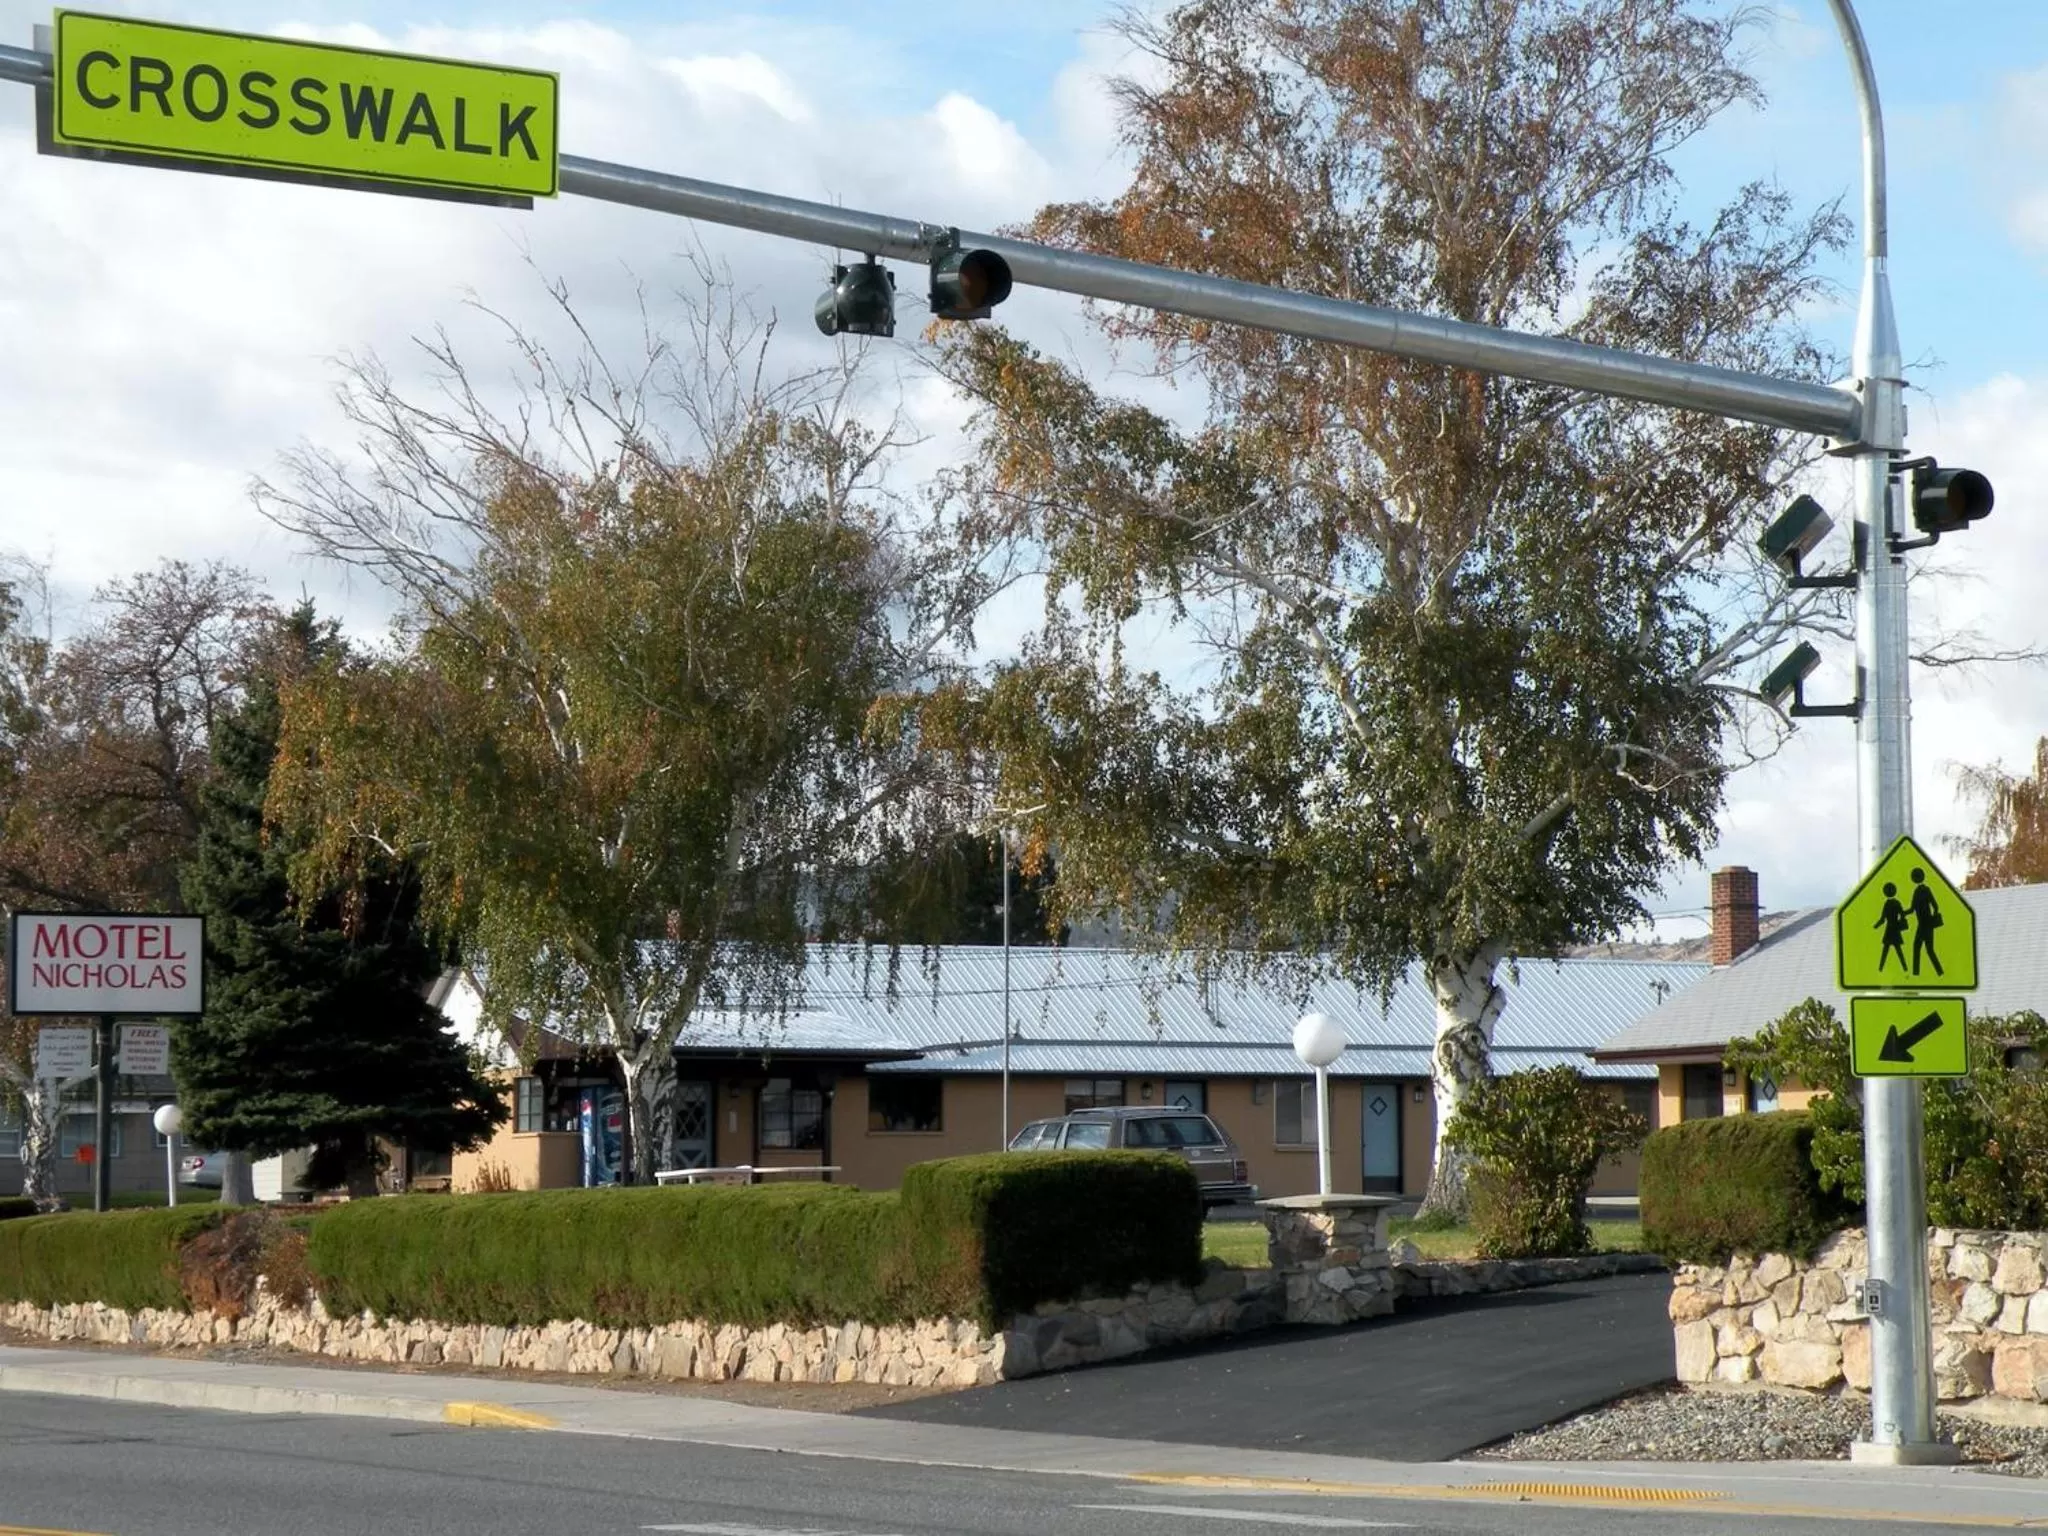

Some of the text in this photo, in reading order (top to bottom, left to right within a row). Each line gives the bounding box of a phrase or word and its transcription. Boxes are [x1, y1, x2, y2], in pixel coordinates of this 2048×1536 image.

[76, 50, 540, 161] CROSSWALK
[33, 923, 186, 960] MOTEL
[33, 963, 186, 989] NICHOLAS
